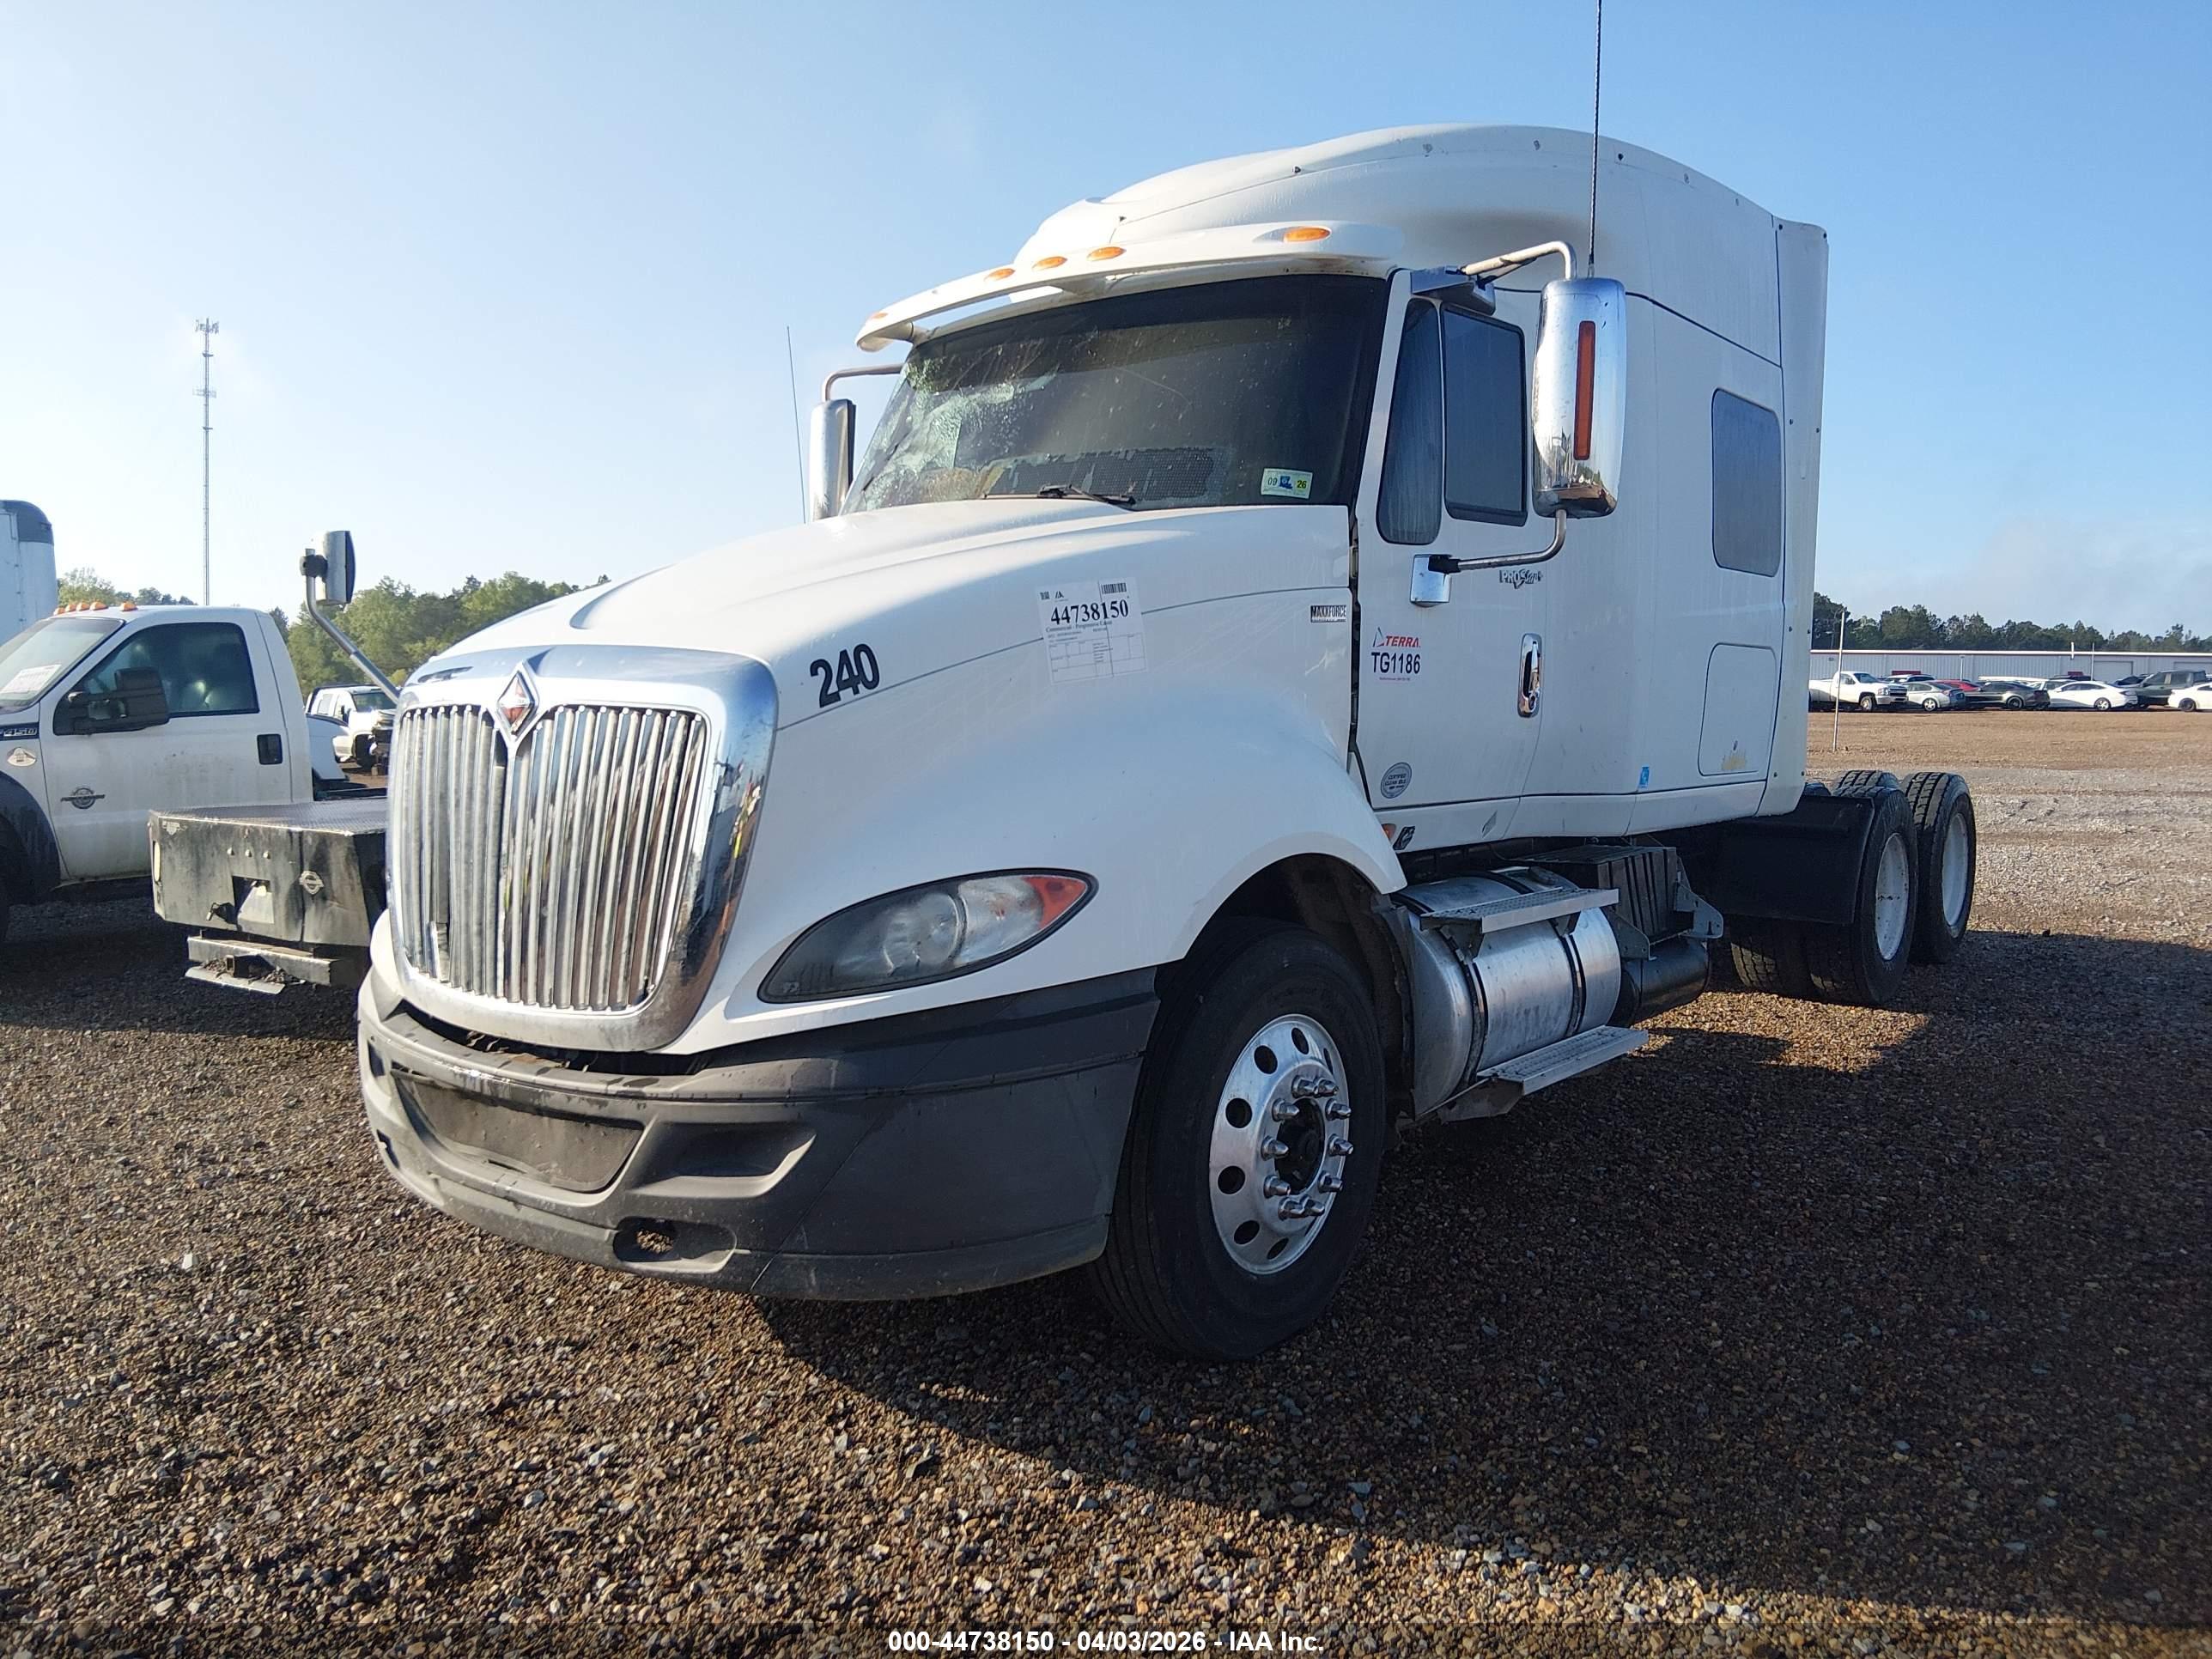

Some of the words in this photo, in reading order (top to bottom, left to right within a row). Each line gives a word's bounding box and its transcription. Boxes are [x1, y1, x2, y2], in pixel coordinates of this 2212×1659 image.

[1297, 480, 1307, 489] 26
[1050, 599, 1128, 625] 44738150
[1311, 605, 1346, 617] MAXXFORCE
[1386, 635, 1419, 647] TERRA
[1371, 652, 1420, 674] TG1186
[810, 644, 879, 708] 240
